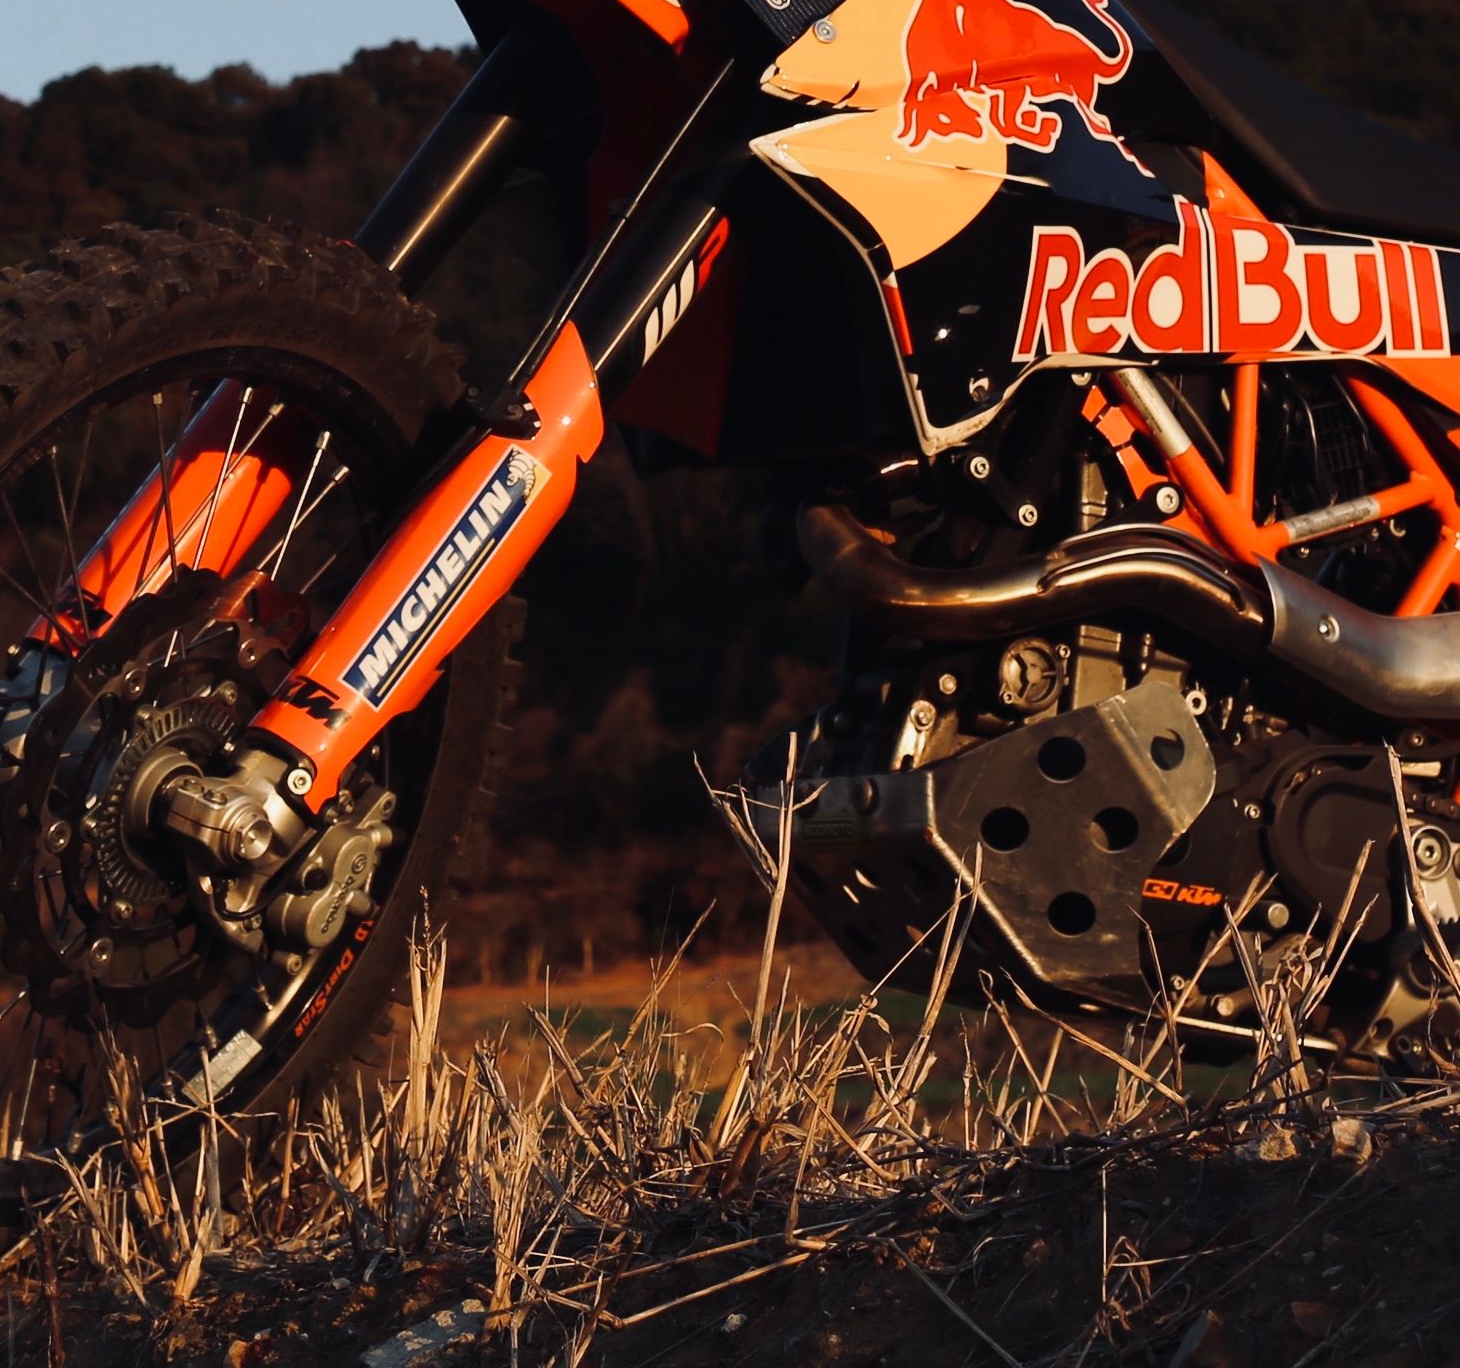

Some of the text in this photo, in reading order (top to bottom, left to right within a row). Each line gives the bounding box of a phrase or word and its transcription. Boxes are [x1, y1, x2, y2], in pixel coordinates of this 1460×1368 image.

[358, 479, 513, 690] MICHELIN
[277, 675, 353, 731] KTM
[1177, 883, 1222, 906] KTM
